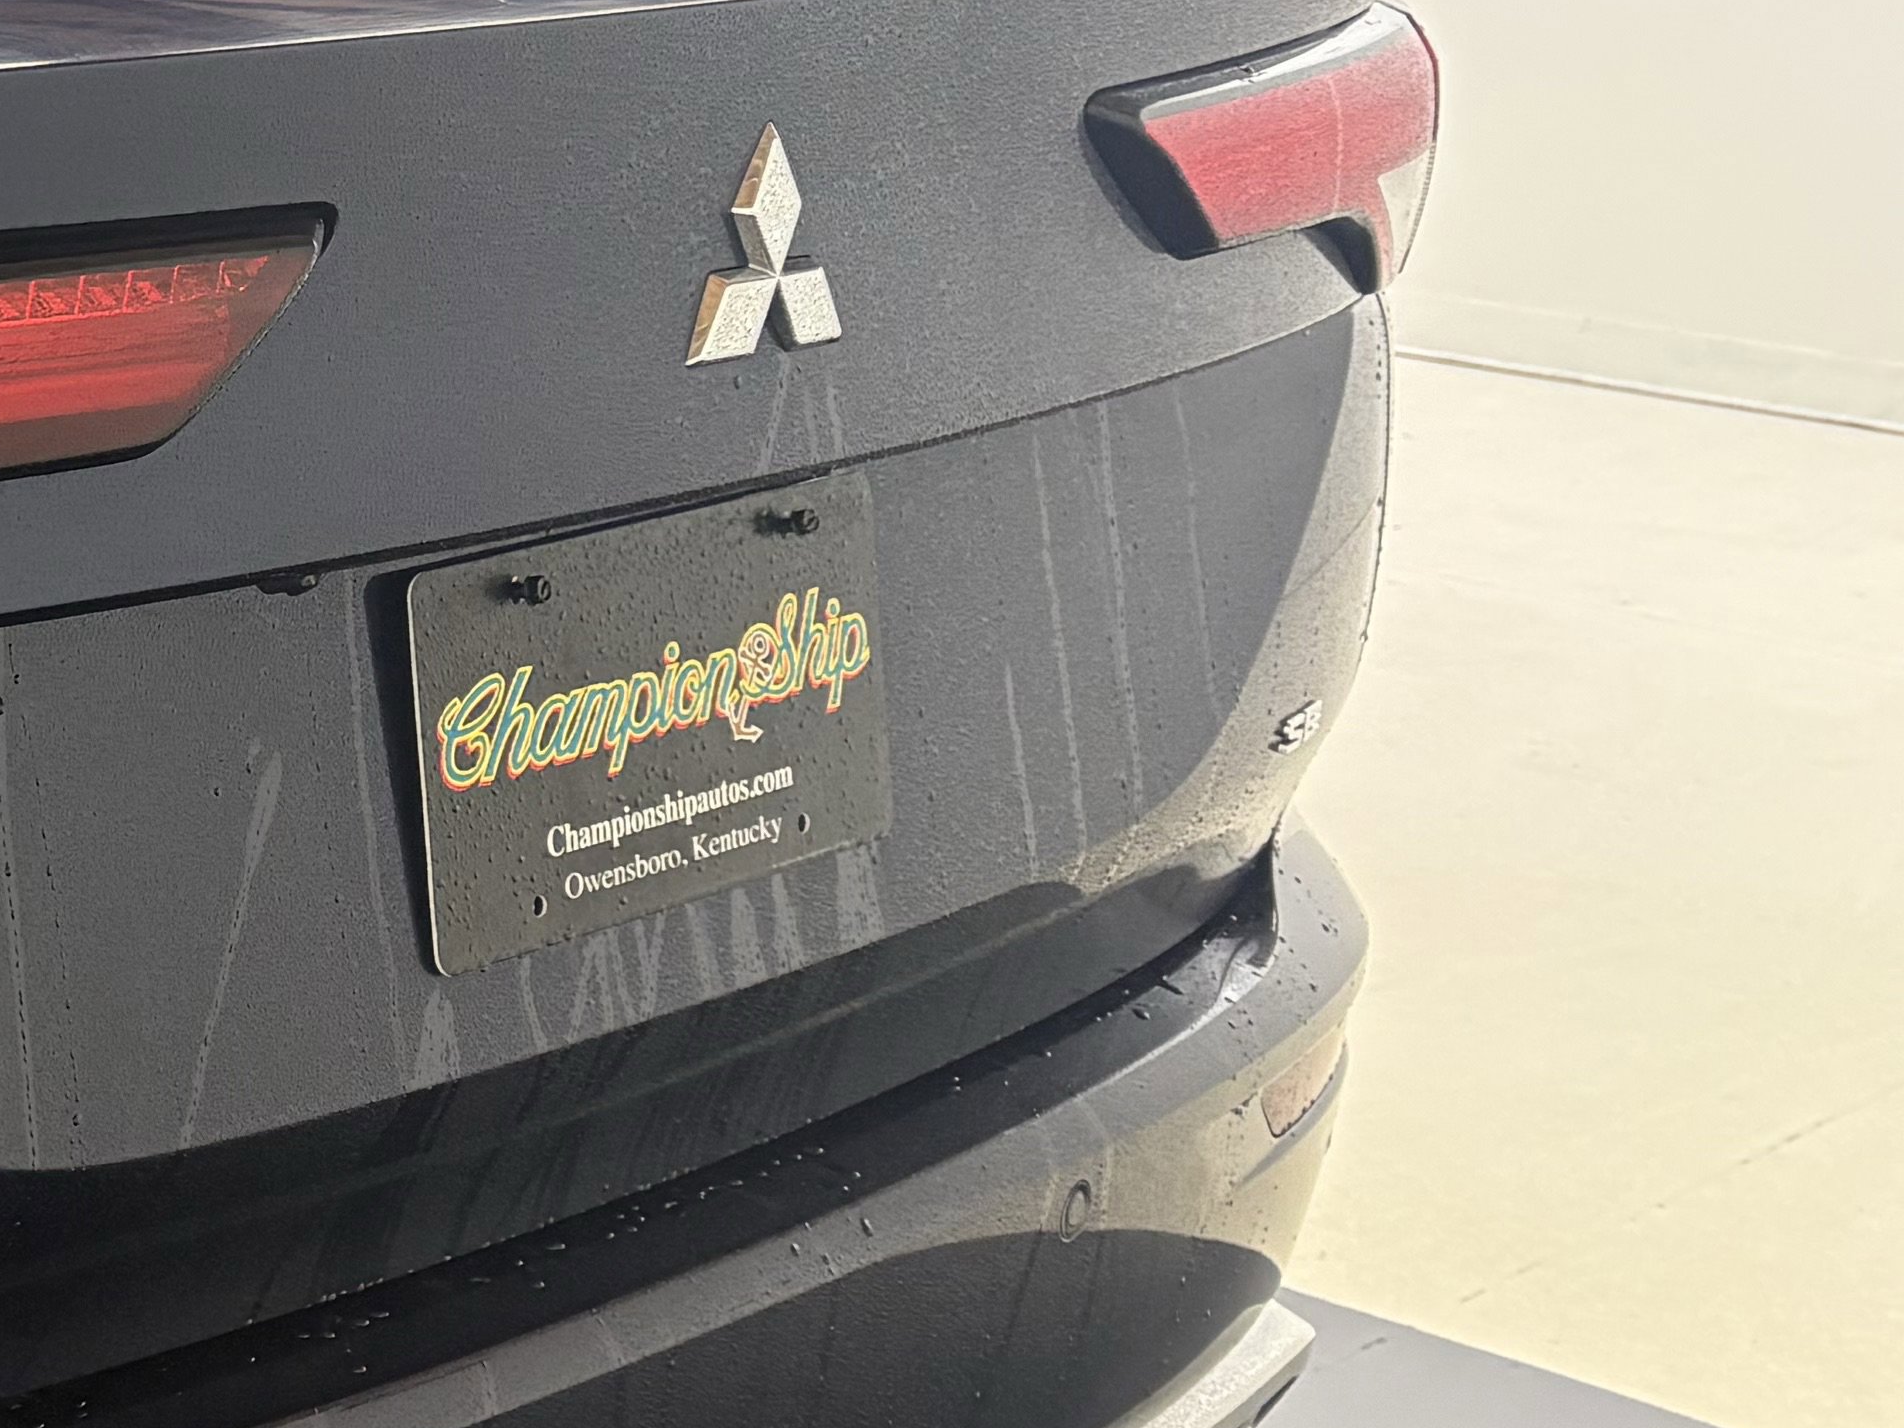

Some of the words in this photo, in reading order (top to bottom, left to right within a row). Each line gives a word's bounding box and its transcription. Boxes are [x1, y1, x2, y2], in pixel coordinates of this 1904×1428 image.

[546, 764, 794, 859] Championshipautos.com
[564, 844, 689, 900] Owensboro,
[691, 813, 783, 861] Kentucky
